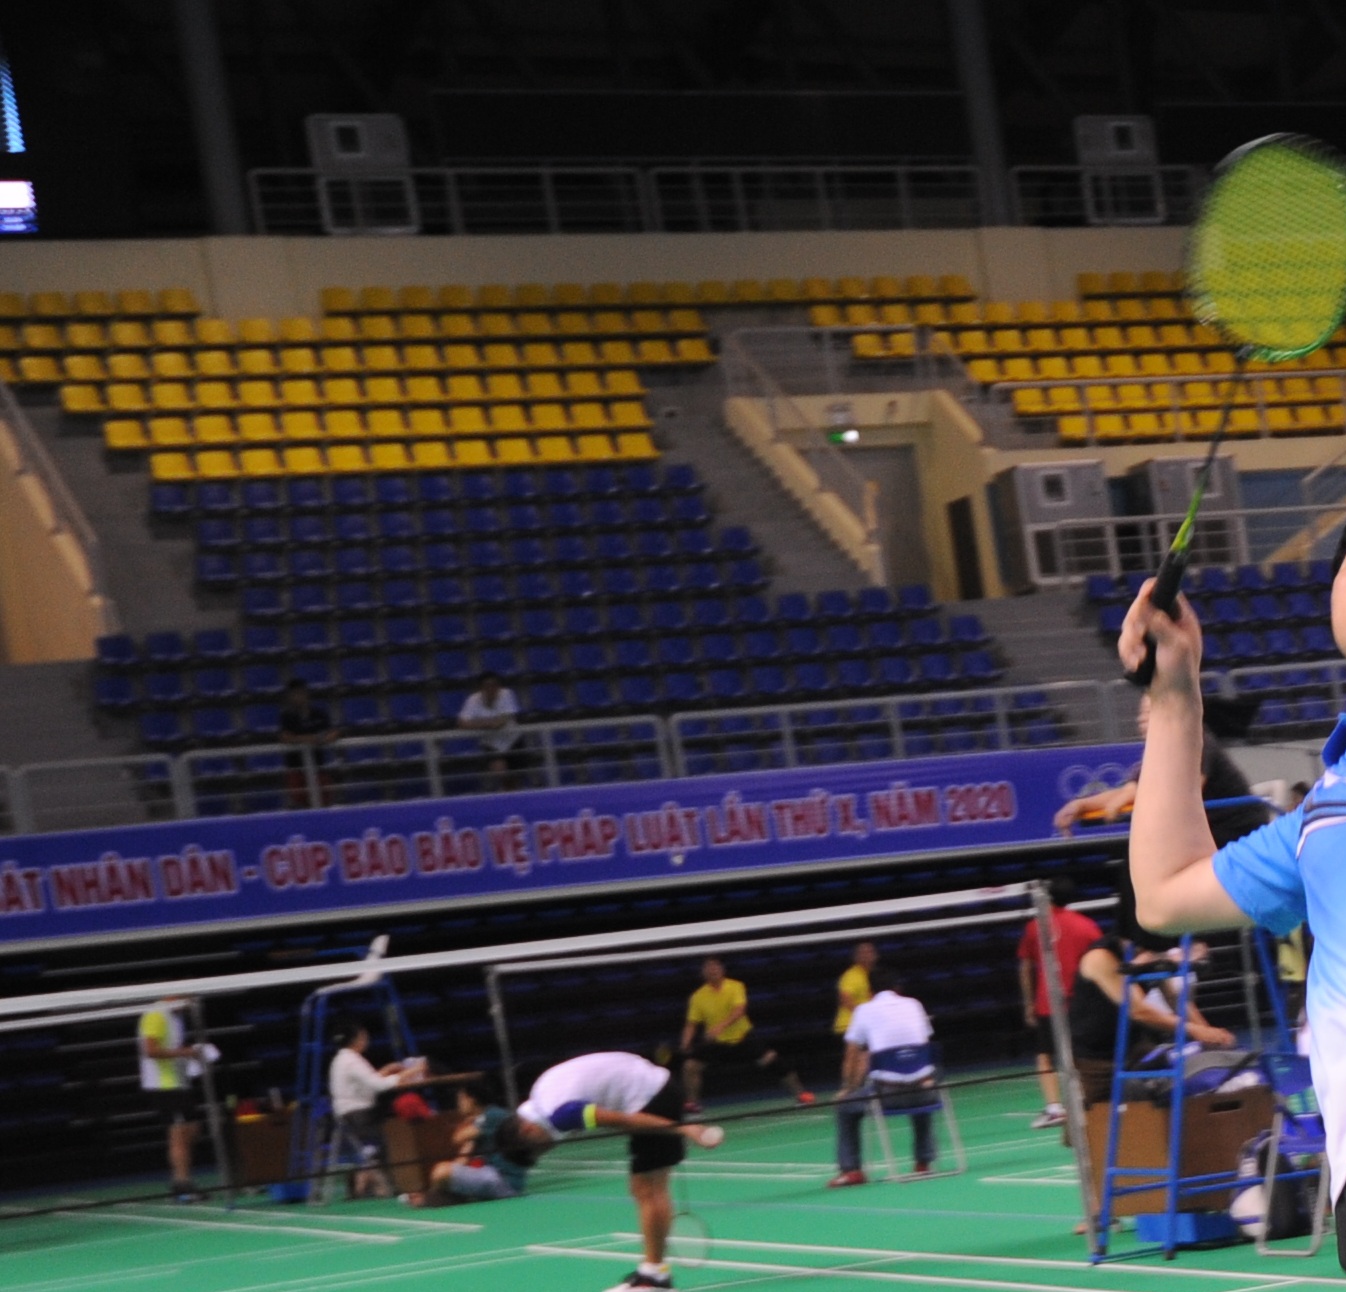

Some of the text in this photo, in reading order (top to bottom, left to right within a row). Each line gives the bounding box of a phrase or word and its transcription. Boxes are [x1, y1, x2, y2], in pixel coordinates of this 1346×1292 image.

[52, 852, 154, 909] NHÂN
[159, 846, 237, 896] DÂN
[262, 836, 330, 889] CÚP
[945, 783, 1016, 822] 2020
